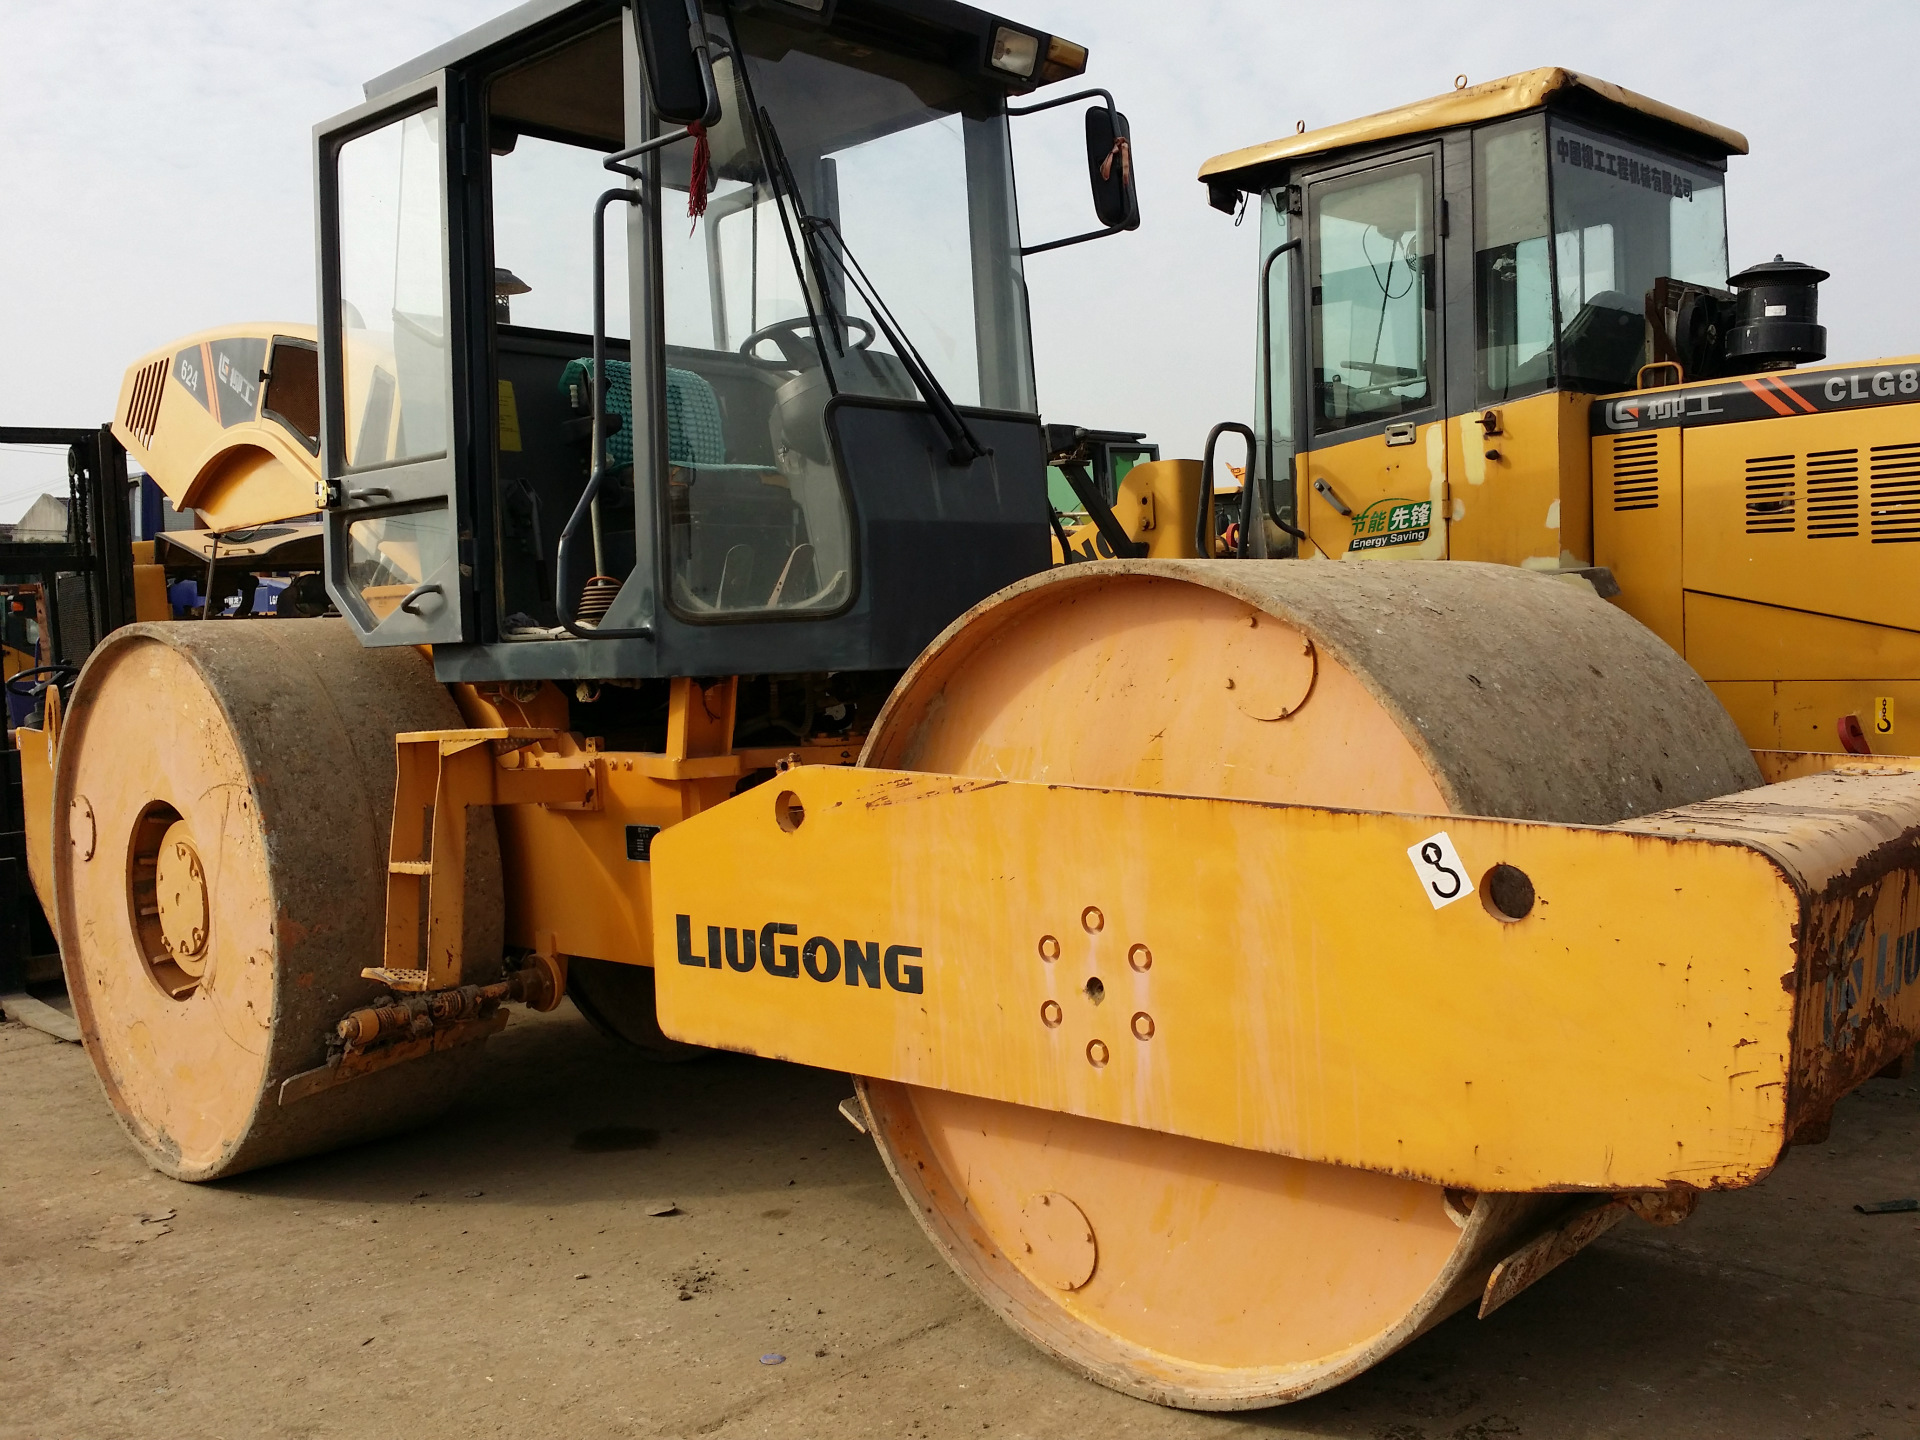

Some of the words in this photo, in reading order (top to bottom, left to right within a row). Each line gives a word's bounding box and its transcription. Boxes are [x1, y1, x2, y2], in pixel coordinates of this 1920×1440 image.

[181, 359, 199, 392] 624
[1824, 368, 1919, 402] CLG8
[1647, 391, 1724, 421] 柳工
[1352, 536, 1388, 549] Energy
[1390, 531, 1426, 543] Saving
